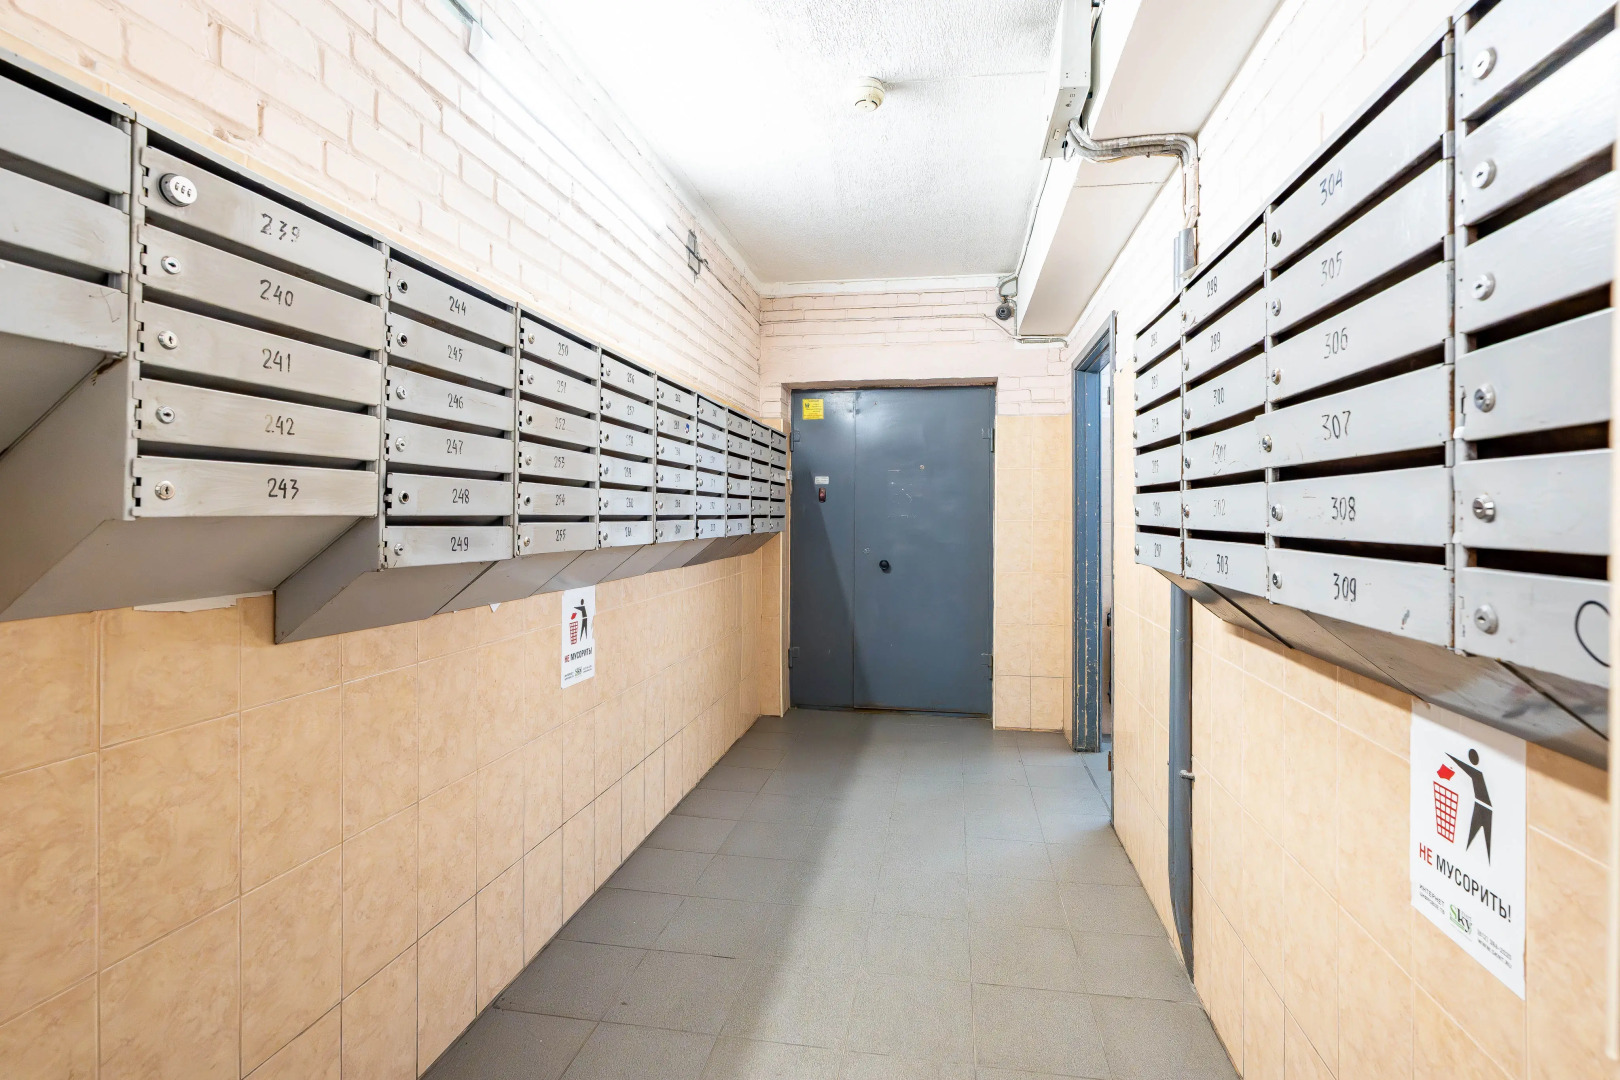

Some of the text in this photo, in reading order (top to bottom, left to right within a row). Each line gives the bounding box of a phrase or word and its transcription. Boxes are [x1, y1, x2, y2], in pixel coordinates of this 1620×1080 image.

[1319, 169, 1343, 206] 304
[260, 213, 301, 242] 239
[1321, 251, 1343, 286] 305
[259, 279, 294, 307] 240
[1206, 276, 1217, 298] 298
[449, 296, 466, 316] 244
[557, 342, 569, 356] 250
[1210, 331, 1221, 352] 299
[1323, 327, 1348, 359] 306
[262, 348, 291, 373] 241
[448, 345, 463, 362] 245
[556, 380, 567, 394] 251
[1213, 387, 1224, 407] 300
[448, 393, 464, 409] 246
[264, 415, 295, 436] 242
[554, 417, 566, 431] 252
[1321, 411, 1351, 440] 307
[446, 438, 463, 455] 247
[553, 456, 565, 468] 253
[267, 478, 299, 500] 243
[452, 488, 470, 505] 248
[555, 494, 566, 506] 254
[1213, 499, 1226, 517] 302
[1331, 496, 1356, 521] 308
[451, 537, 469, 552] 249
[555, 530, 566, 542] 255
[1216, 554, 1229, 575] 303
[1333, 573, 1357, 602] 309
[1419, 842, 1433, 867] НЕ
[1436, 854, 1512, 924] МУСОРИТЬ!
